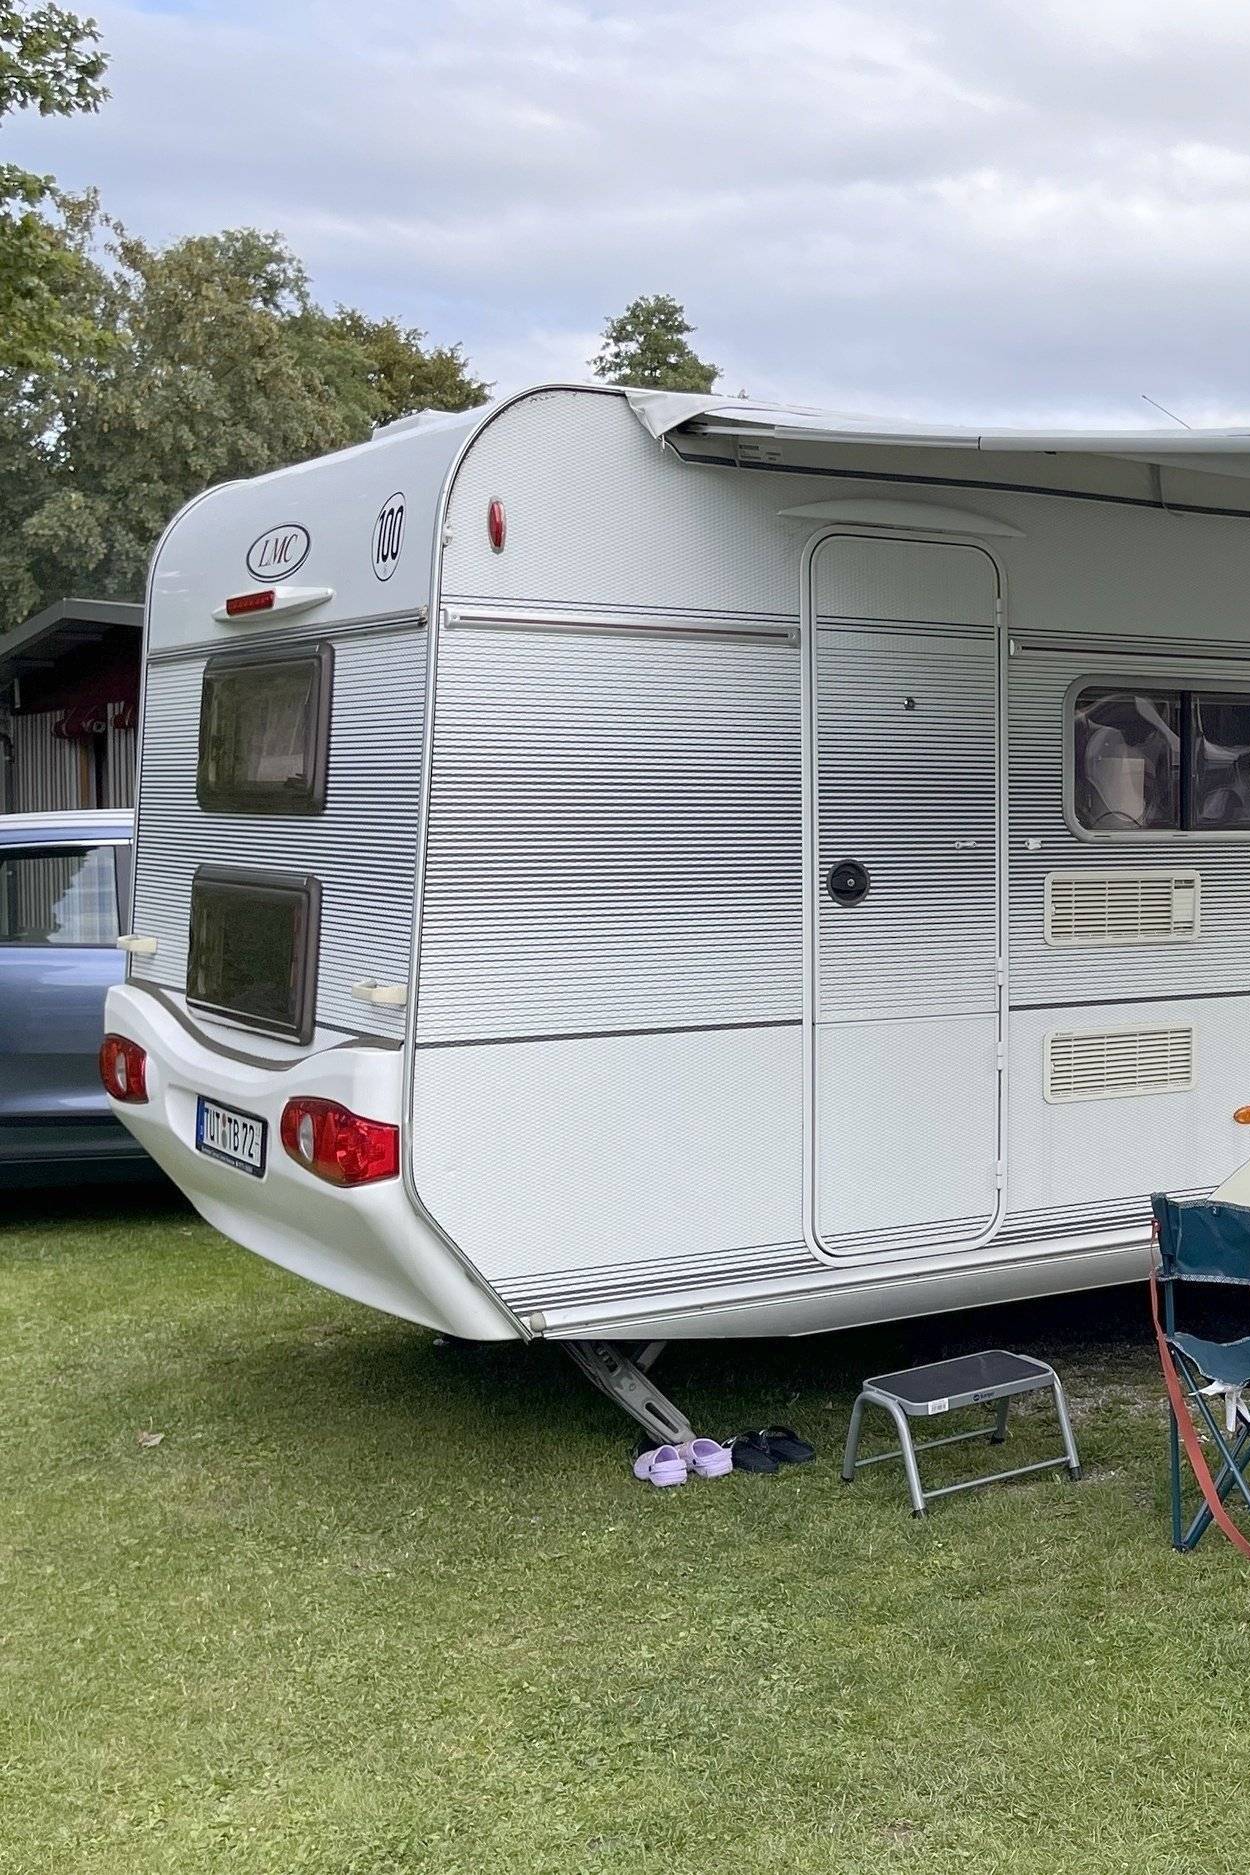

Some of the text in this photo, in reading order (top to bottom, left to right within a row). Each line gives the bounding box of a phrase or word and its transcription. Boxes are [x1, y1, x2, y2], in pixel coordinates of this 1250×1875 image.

[258, 533, 298, 568] LMC
[376, 505, 404, 564] 100
[227, 1116, 240, 1152] TB
[242, 1122, 255, 1158] 72
